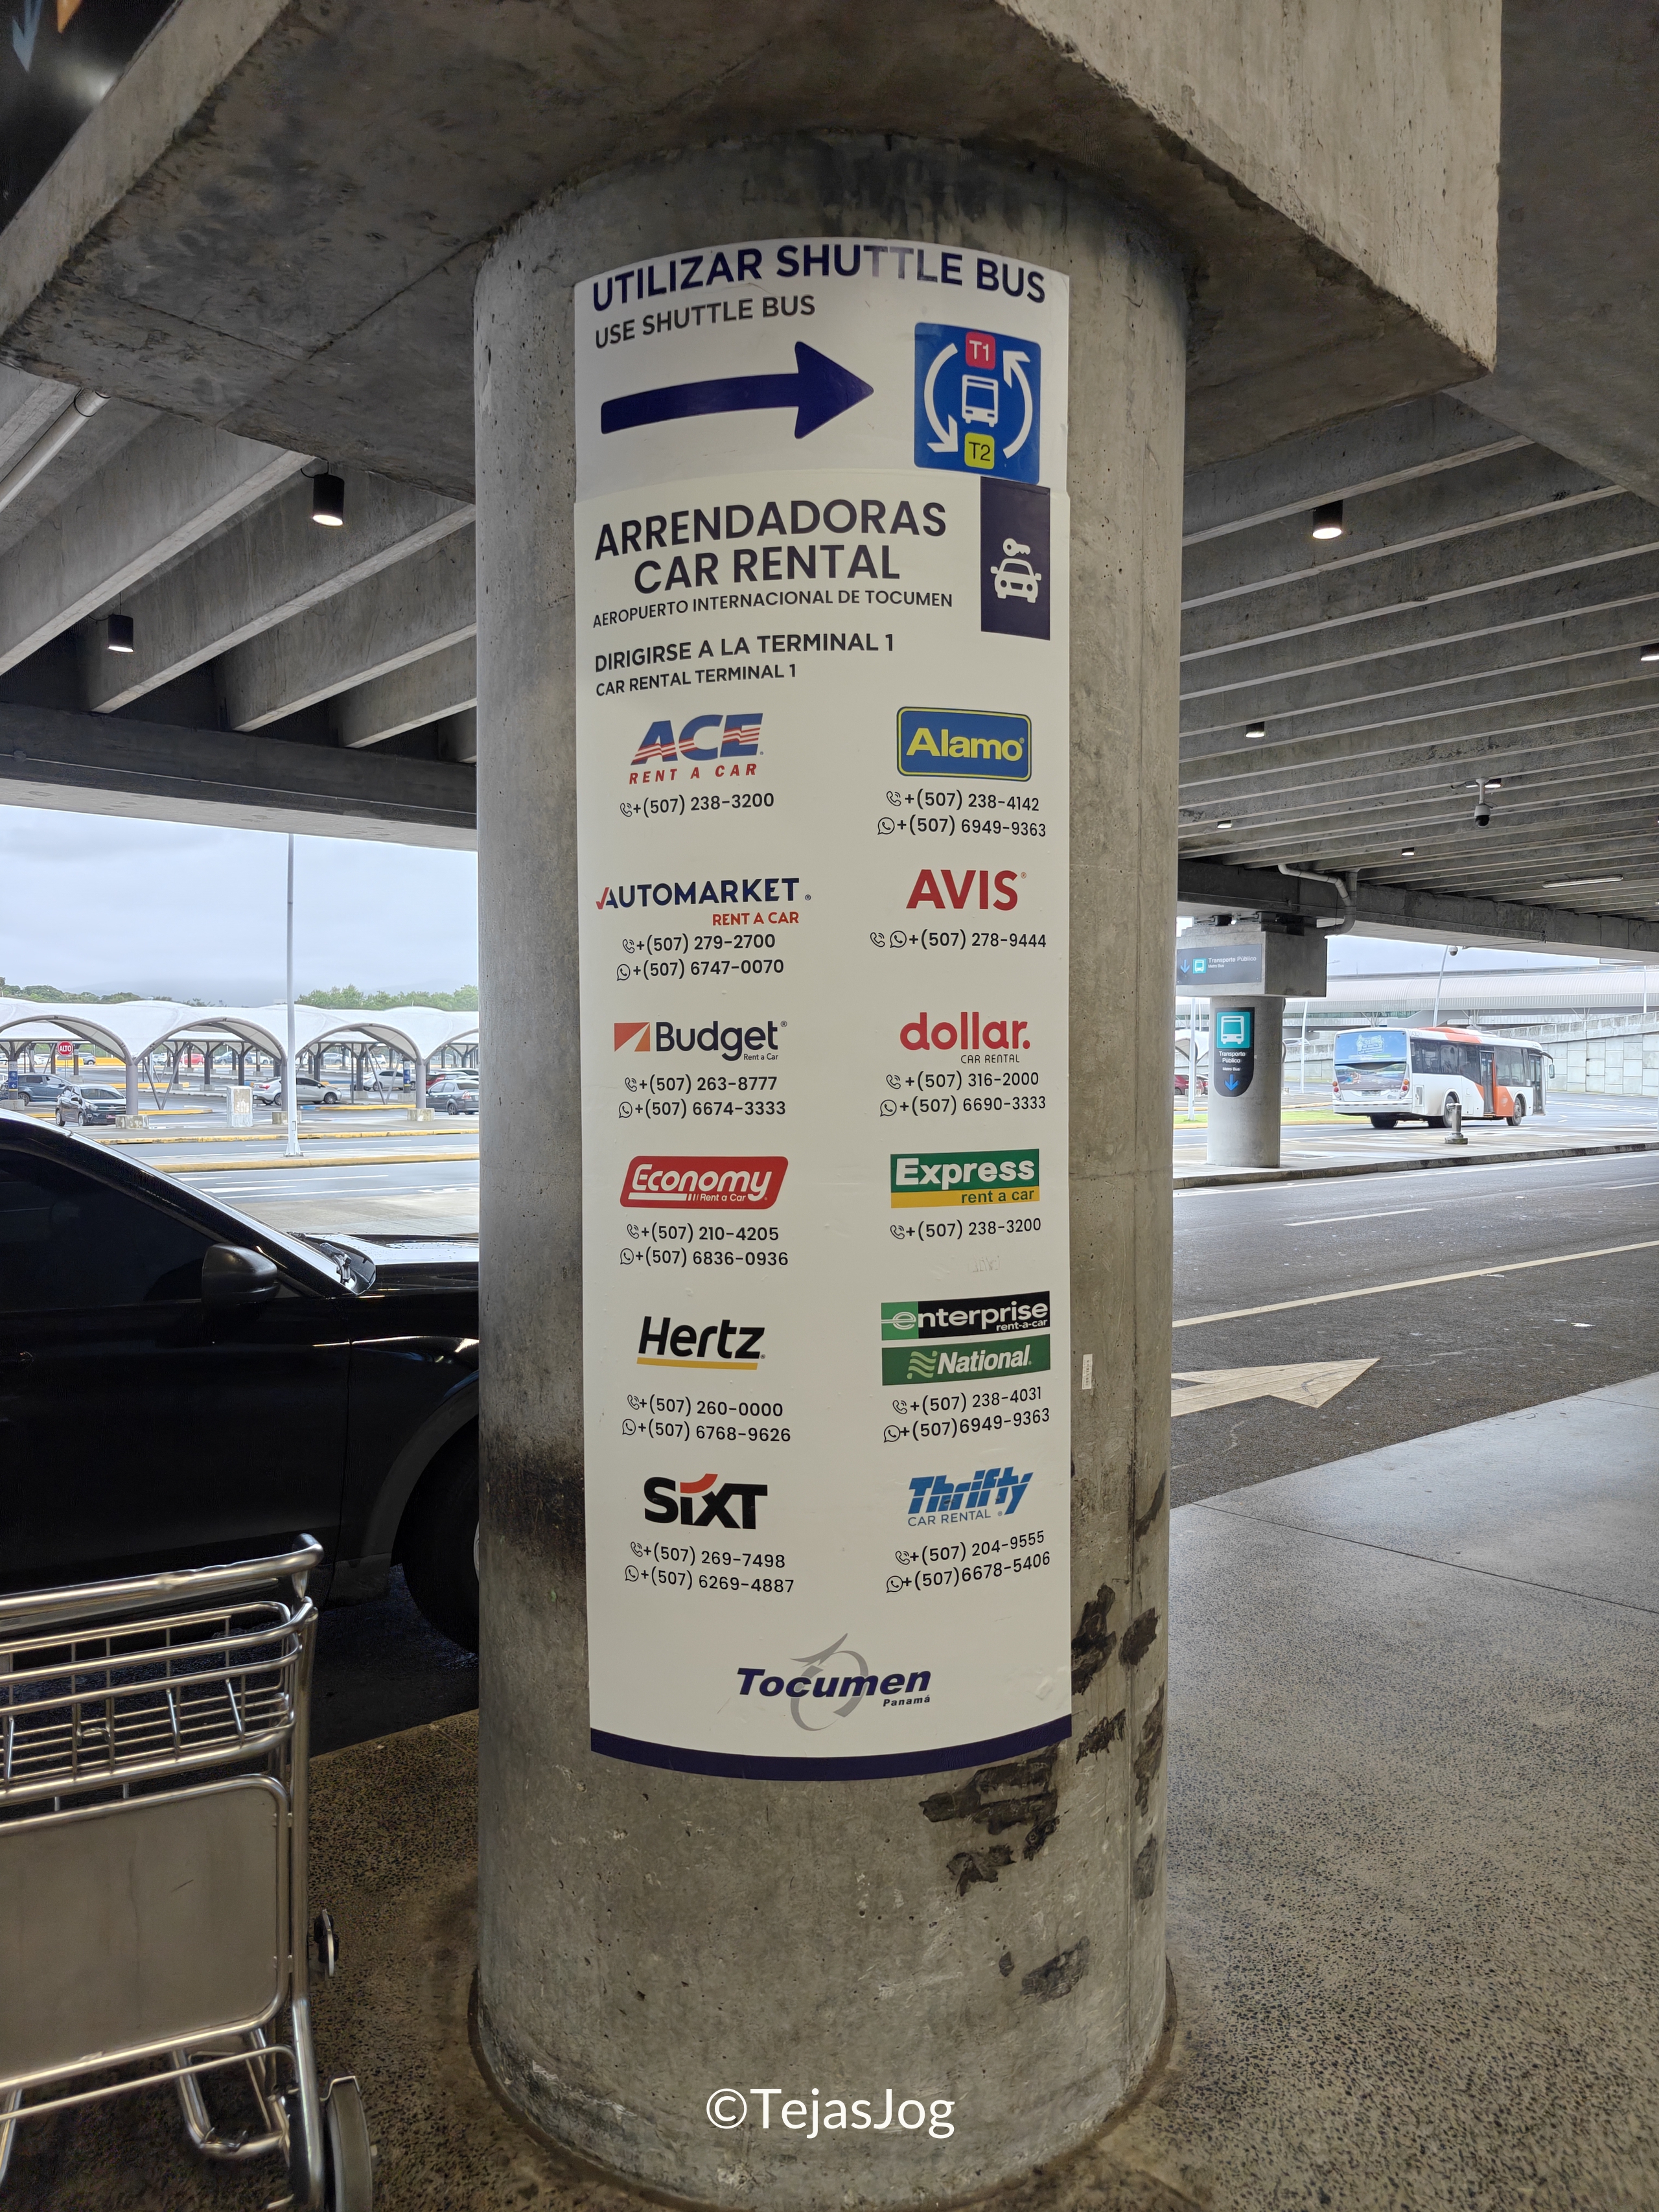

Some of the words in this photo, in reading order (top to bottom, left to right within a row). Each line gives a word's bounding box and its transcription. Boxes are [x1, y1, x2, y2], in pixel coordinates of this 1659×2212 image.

[593, 248, 763, 310] UTILIZAR
[777, 244, 963, 285] SHUTTLE
[977, 259, 1045, 303] BUS
[596, 321, 635, 348] USE
[642, 297, 753, 336] SHUTTLE
[763, 294, 815, 317] BUS
[969, 340, 990, 362] T1
[969, 443, 990, 461] T2
[595, 499, 946, 560] ARRENDADORAS
[634, 553, 719, 594] CAR
[734, 544, 899, 582] RENTAL
[593, 600, 688, 628] AEROPUERTO
[693, 590, 833, 612] INTERNACIONAL
[839, 590, 860, 605] DE
[866, 591, 953, 607] TOCUMEN
[595, 642, 691, 673] DIRIGIRSE
[699, 640, 713, 657] A
[721, 636, 750, 656] LA
[757, 633, 878, 653] TERMINAL
[885, 634, 894, 651] 1
[596, 679, 624, 697] CAR
[629, 671, 690, 692] RENTAL
[695, 664, 784, 684] TERMINAL
[789, 664, 796, 677] 1
[631, 713, 763, 765] ACE
[906, 728, 1023, 761] Alamo
[629, 769, 677, 784] RENT
[690, 767, 700, 779] A
[715, 763, 757, 777] CAR
[633, 794, 684, 818] +(507)
[691, 793, 774, 810] 238-3200
[905, 789, 962, 810] +(507)
[968, 794, 1039, 811] 238-4142
[897, 815, 955, 836] +(507)
[962, 819, 1045, 837] 6949-9363
[596, 878, 799, 909] AUTOMARKET
[906, 869, 1017, 911] AVIS
[713, 913, 750, 926] RENT
[753, 913, 764, 924] A
[768, 912, 799, 924] CAR
[637, 933, 688, 955] +(507)
[694, 934, 775, 949] 279-2700
[909, 929, 966, 949] +(507)
[972, 933, 1046, 948] 278-9444
[633, 959, 684, 980] +(507)
[691, 960, 783, 975] 6747-0070
[656, 1021, 778, 1061] Budget
[961, 1055, 980, 1064] CAR
[985, 1054, 1019, 1063] RENTAL
[639, 1074, 691, 1094] +(507)
[697, 1077, 777, 1091] 263-8777
[905, 1071, 962, 1091] +(507)
[968, 1072, 1038, 1088] 316-2000
[635, 1099, 686, 1119] +(507)
[693, 1102, 785, 1115] 6674-3333
[899, 1095, 957, 1116] +(507)
[963, 1096, 1045, 1111] 6690-3333
[632, 1164, 772, 1202] Economy
[896, 1158, 1034, 1190] Express
[962, 1190, 993, 1203] rent
[998, 1193, 1006, 1202] a
[1012, 1190, 1034, 1200] car
[642, 1222, 693, 1243] +(507)
[699, 1227, 778, 1240] 210-4205
[906, 1220, 962, 1241] +(507)
[968, 1218, 1041, 1235] 238-3200
[636, 1246, 686, 1267] +(507)
[693, 1252, 788, 1265] 6836-0936
[888, 1301, 1048, 1330] enterprise
[997, 1320, 1047, 1331] rent-a-car
[638, 1316, 765, 1358] Hertz
[937, 1344, 1030, 1374] National
[640, 1394, 691, 1417] +(507)
[697, 1401, 783, 1416] 260-0000
[911, 1393, 966, 1415] +(507)
[973, 1386, 1041, 1408] 238-4031
[638, 1418, 690, 1441] +(507)
[696, 1425, 791, 1441] 6768-9626
[908, 1466, 1033, 1515] Thrifty
[908, 1515, 935, 1526] CAR
[941, 1509, 991, 1524] RENTAL
[644, 1543, 695, 1566] +(507)
[701, 1551, 785, 1568] 269-7498
[910, 1542, 966, 1566] +(507)
[972, 1530, 1044, 1557] 204-9555
[641, 1566, 692, 1590] +(507)
[699, 1575, 794, 1592] 6269-4887
[737, 1668, 931, 1698] Tocumen
[883, 1694, 930, 1706] Panamá
